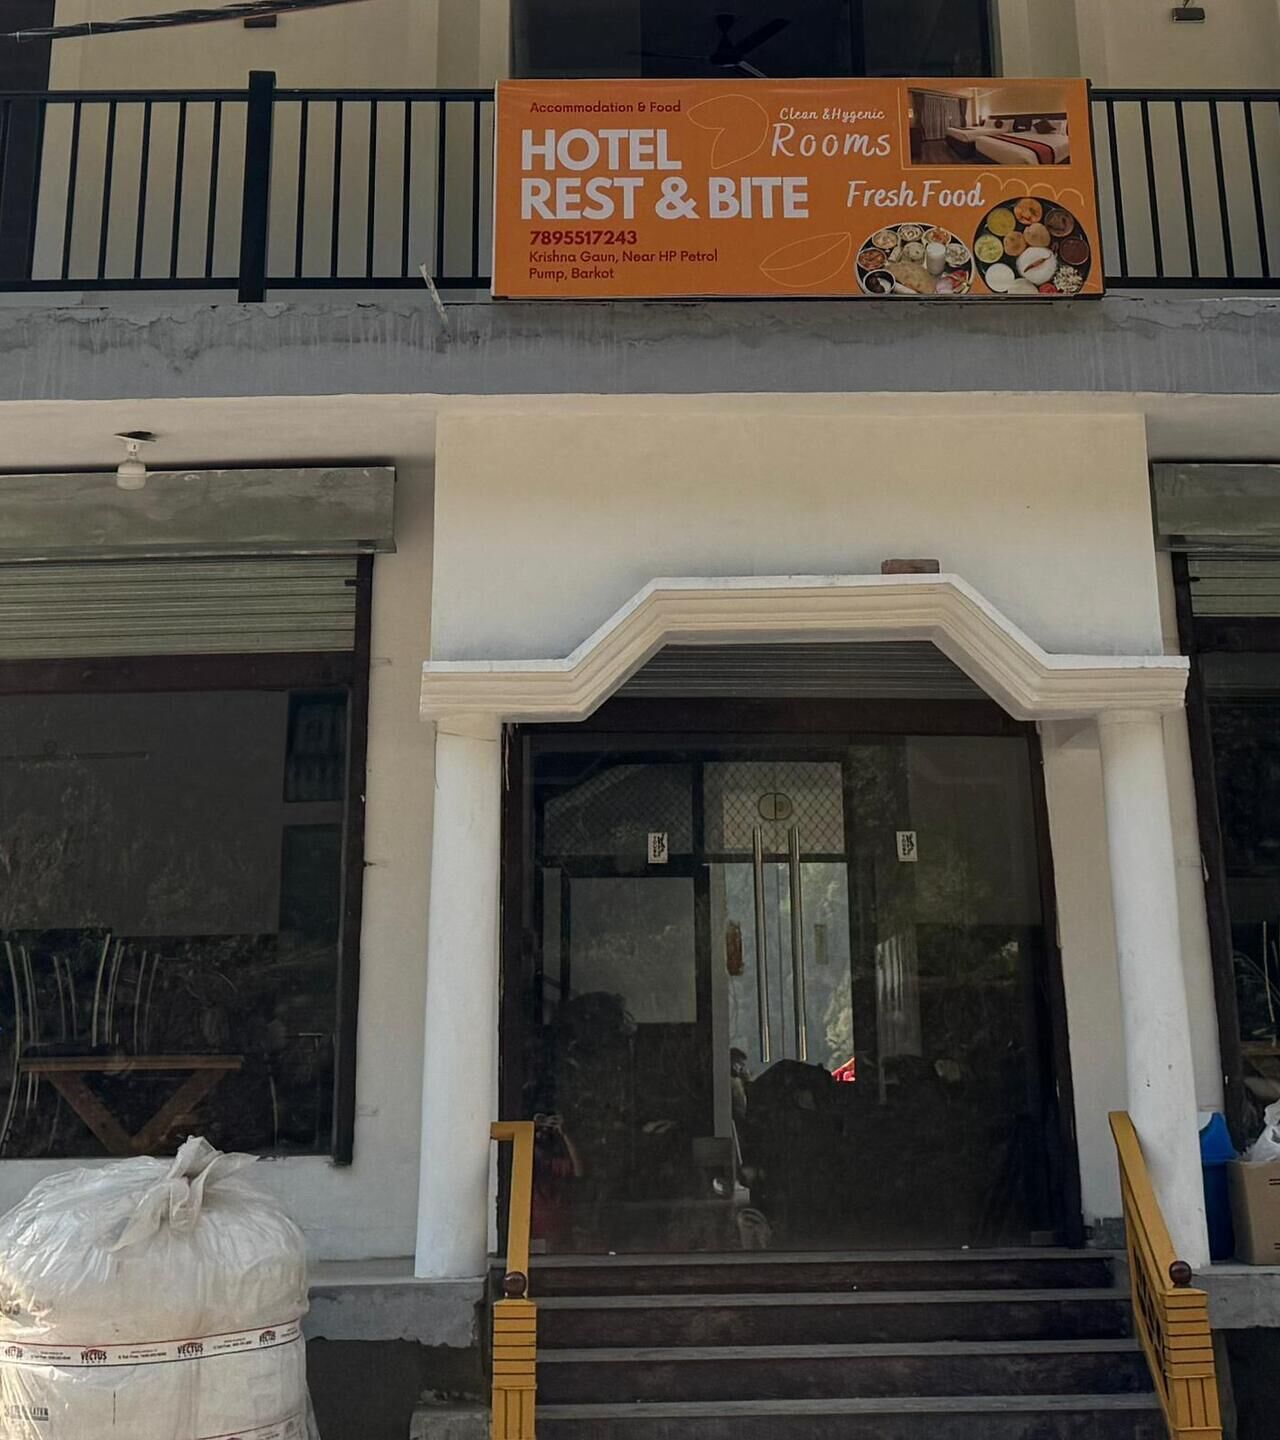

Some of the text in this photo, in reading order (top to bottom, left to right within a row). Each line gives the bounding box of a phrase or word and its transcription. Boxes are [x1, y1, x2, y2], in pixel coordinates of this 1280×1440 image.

[530, 100, 682, 113] Accommodation & Food
[779, 108, 818, 121] Clean
[772, 123, 891, 157] Rooms
[522, 129, 681, 170] HOTEL
[522, 177, 808, 220] REST & BITE
[848, 181, 985, 207] Fresh Food
[530, 230, 638, 245] 7895517243
[529, 249, 717, 265] Krishna Gaun, Near HP Petrol
[529, 267, 615, 283] Pump, Barkot
[80, 1349, 107, 1361] VECTUS
[177, 1342, 204, 1354] VECTUS
